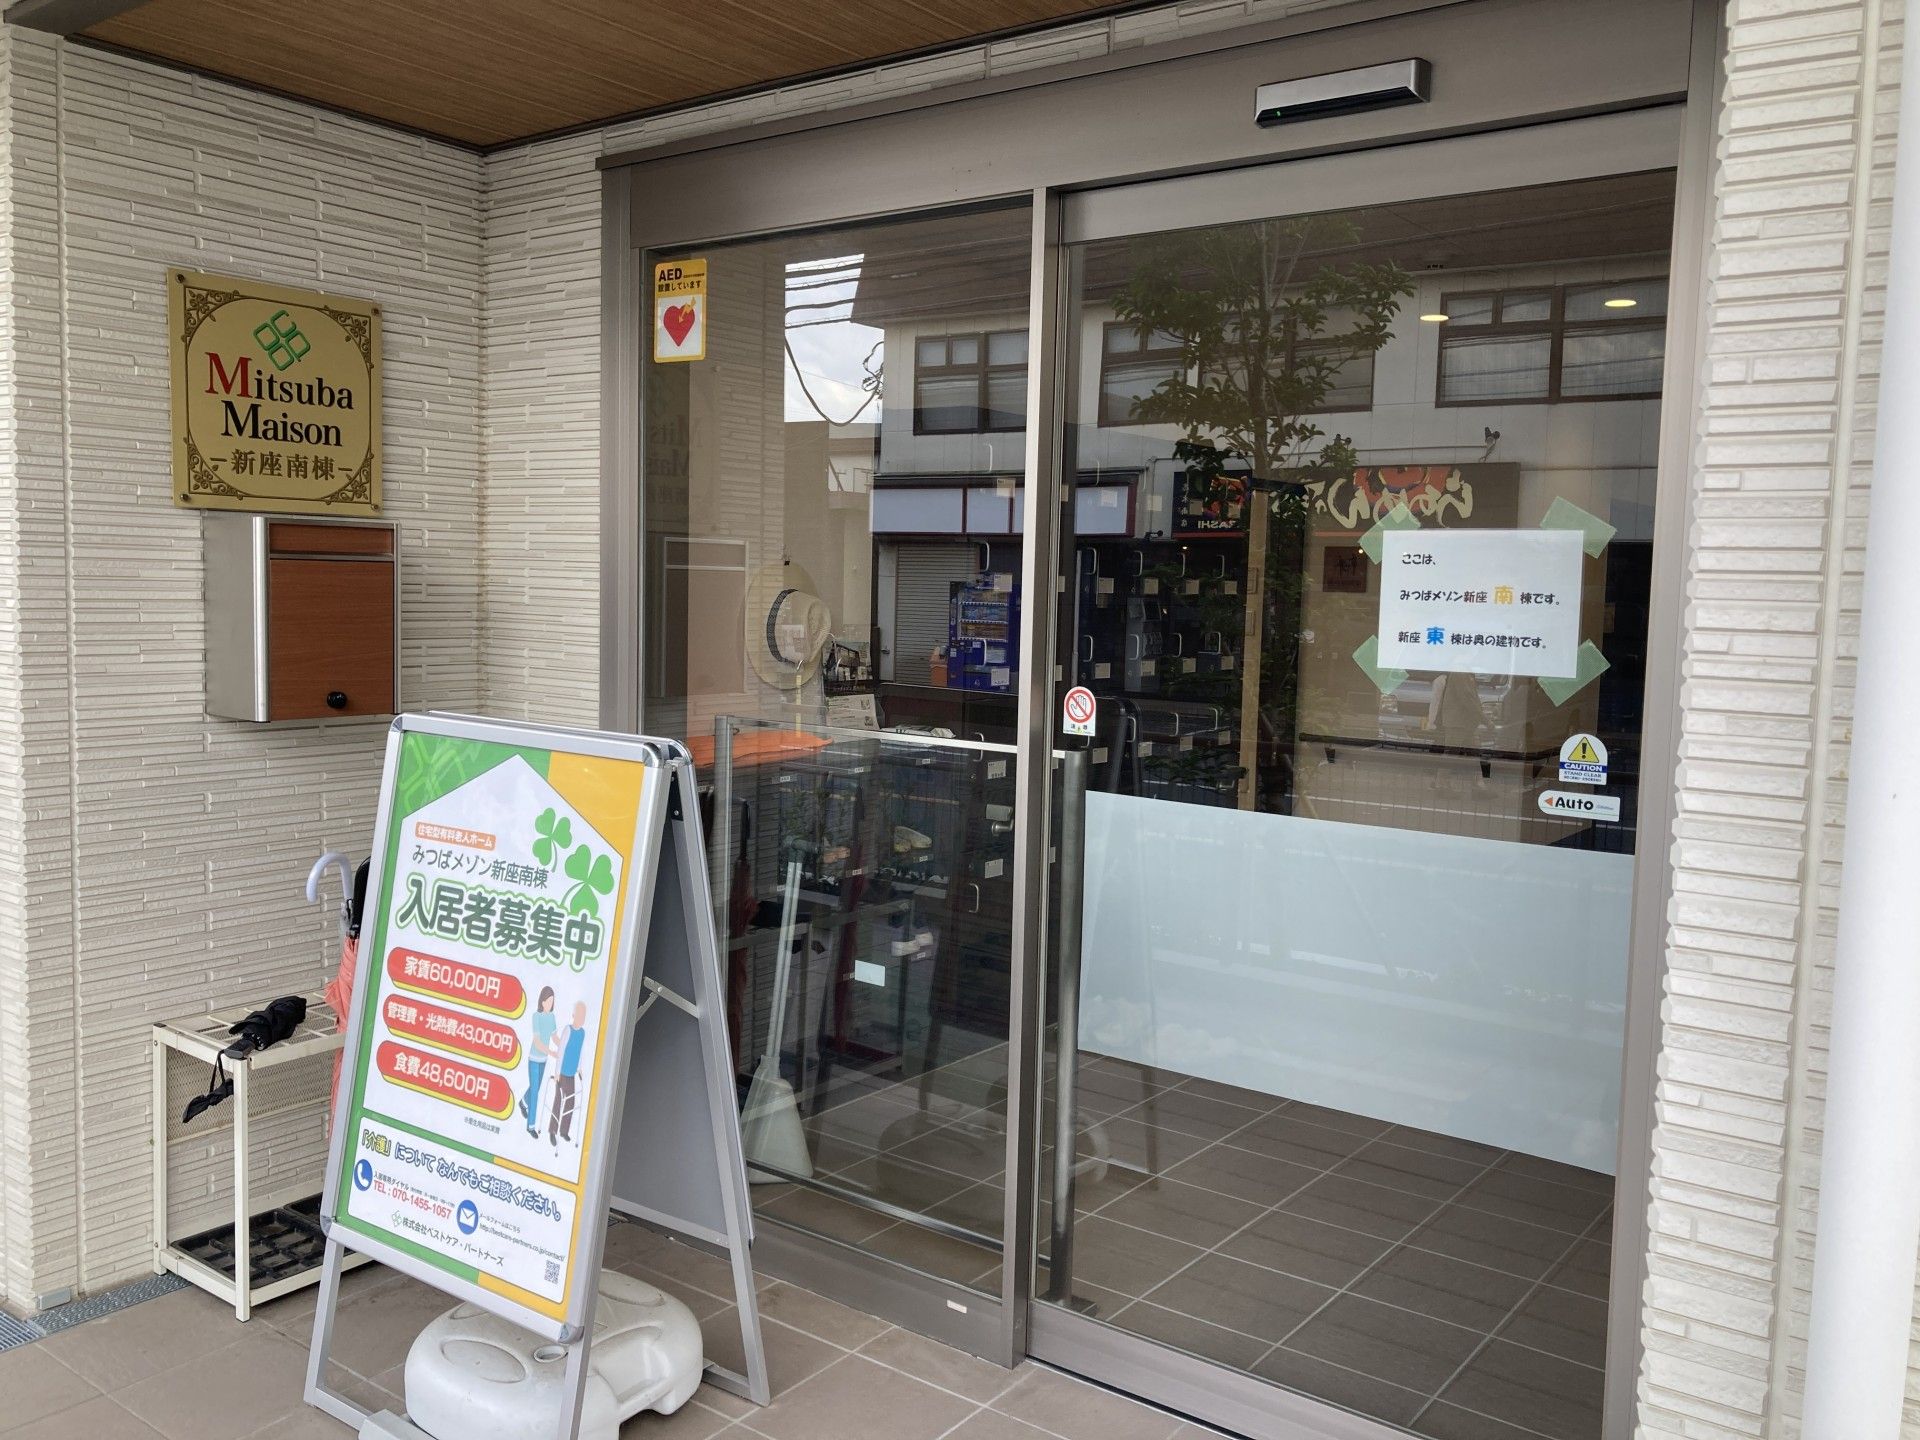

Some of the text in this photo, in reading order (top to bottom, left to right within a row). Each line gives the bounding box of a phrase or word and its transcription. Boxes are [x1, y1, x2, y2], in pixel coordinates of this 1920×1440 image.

[659, 268, 682, 282] AED
[204, 351, 354, 410] Mitsuba
[220, 400, 343, 447] Maison
[1401, 553, 1437, 566] ここは、
[1399, 585, 1561, 606] みつばメゾン新座 南 棟です。
[1398, 631, 1421, 644] 新座
[1426, 626, 1445, 645] 東
[1563, 763, 1603, 772] CAUTION
[1555, 797, 1594, 811] Auto
[412, 845, 549, 889] みつばメゾン新座南棟
[399, 879, 600, 966] 入居者募集中
[403, 956, 502, 999] 家賃60,000円
[393, 1052, 490, 1101] 食費48,600円
